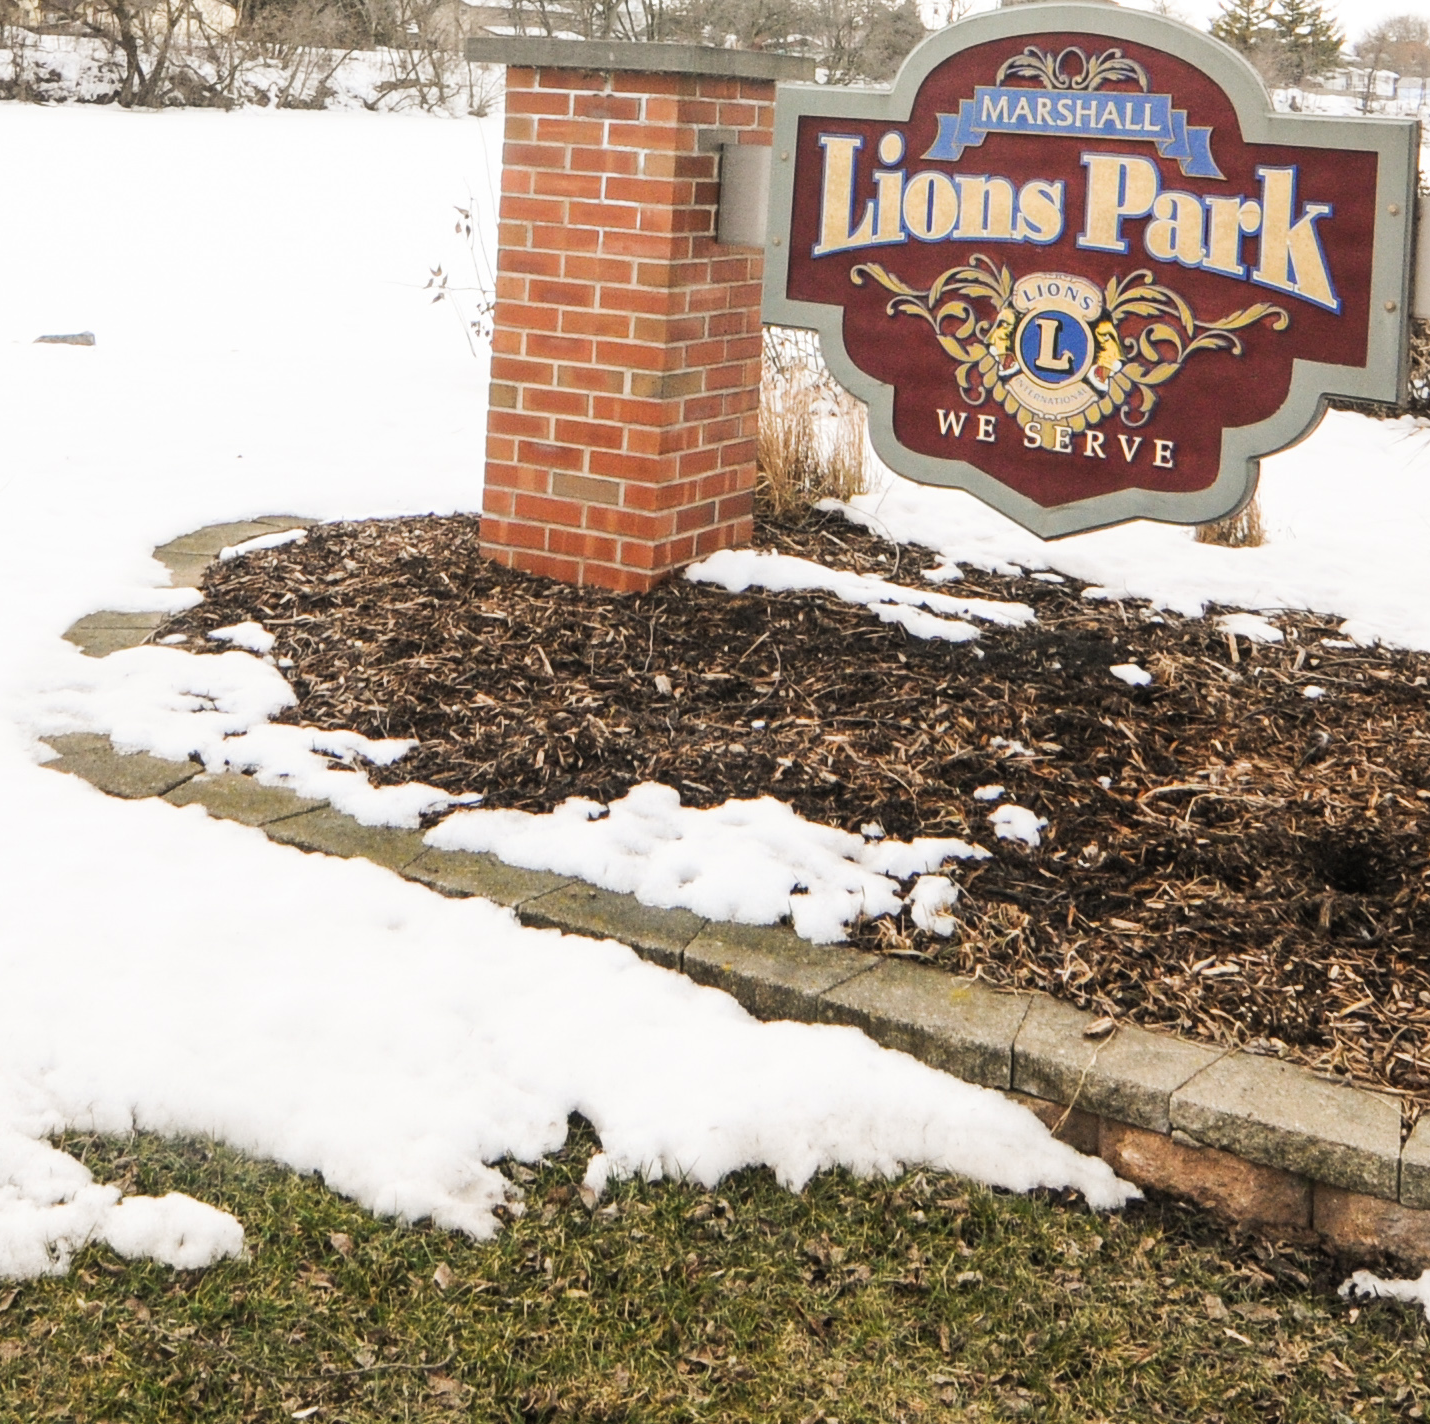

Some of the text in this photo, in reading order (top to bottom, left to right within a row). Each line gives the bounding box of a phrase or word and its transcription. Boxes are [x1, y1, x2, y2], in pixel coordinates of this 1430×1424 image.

[981, 95, 1161, 131] MARSHALL
[811, 130, 1341, 316] Lions Park
[1023, 282, 1094, 311] LIONS
[1035, 317, 1074, 373] L
[1014, 377, 1088, 405] INTERNATIONAL
[936, 408, 1175, 469] WE SERVE
